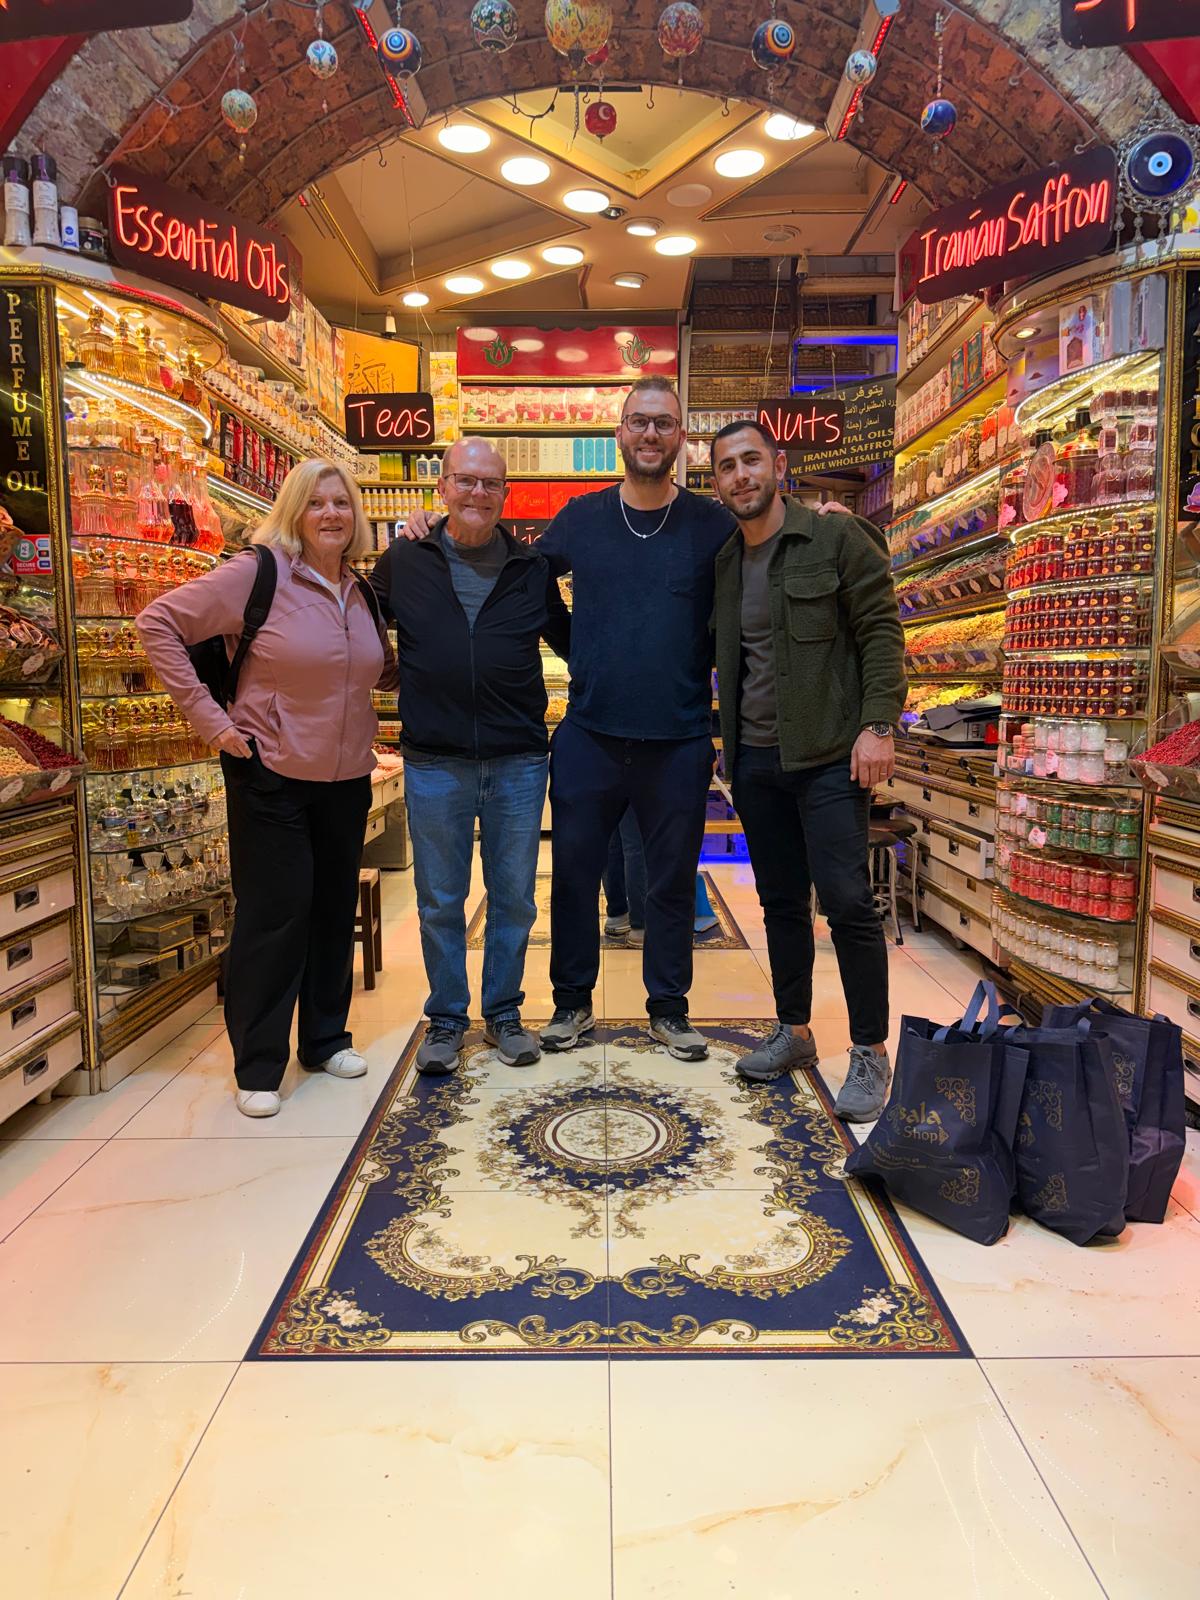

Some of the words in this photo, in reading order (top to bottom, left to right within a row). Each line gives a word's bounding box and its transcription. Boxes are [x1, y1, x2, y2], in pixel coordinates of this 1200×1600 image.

[918, 209, 1006, 284] Iranian
[1007, 172, 1109, 252] Saffron
[115, 186, 240, 283] Essential
[246, 239, 290, 304] Oils
[7, 292, 33, 461] PERFUME
[348, 401, 432, 438] Teas
[760, 406, 841, 443] Nuts
[867, 428, 894, 439] OILS
[790, 466, 802, 475] WE
[805, 462, 826, 473] HAVE
[828, 452, 881, 468] WHOLESALE
[803, 448, 847, 462] IRANIAN
[6, 470, 44, 492] OIL
[903, 1125, 938, 1144] Shop
